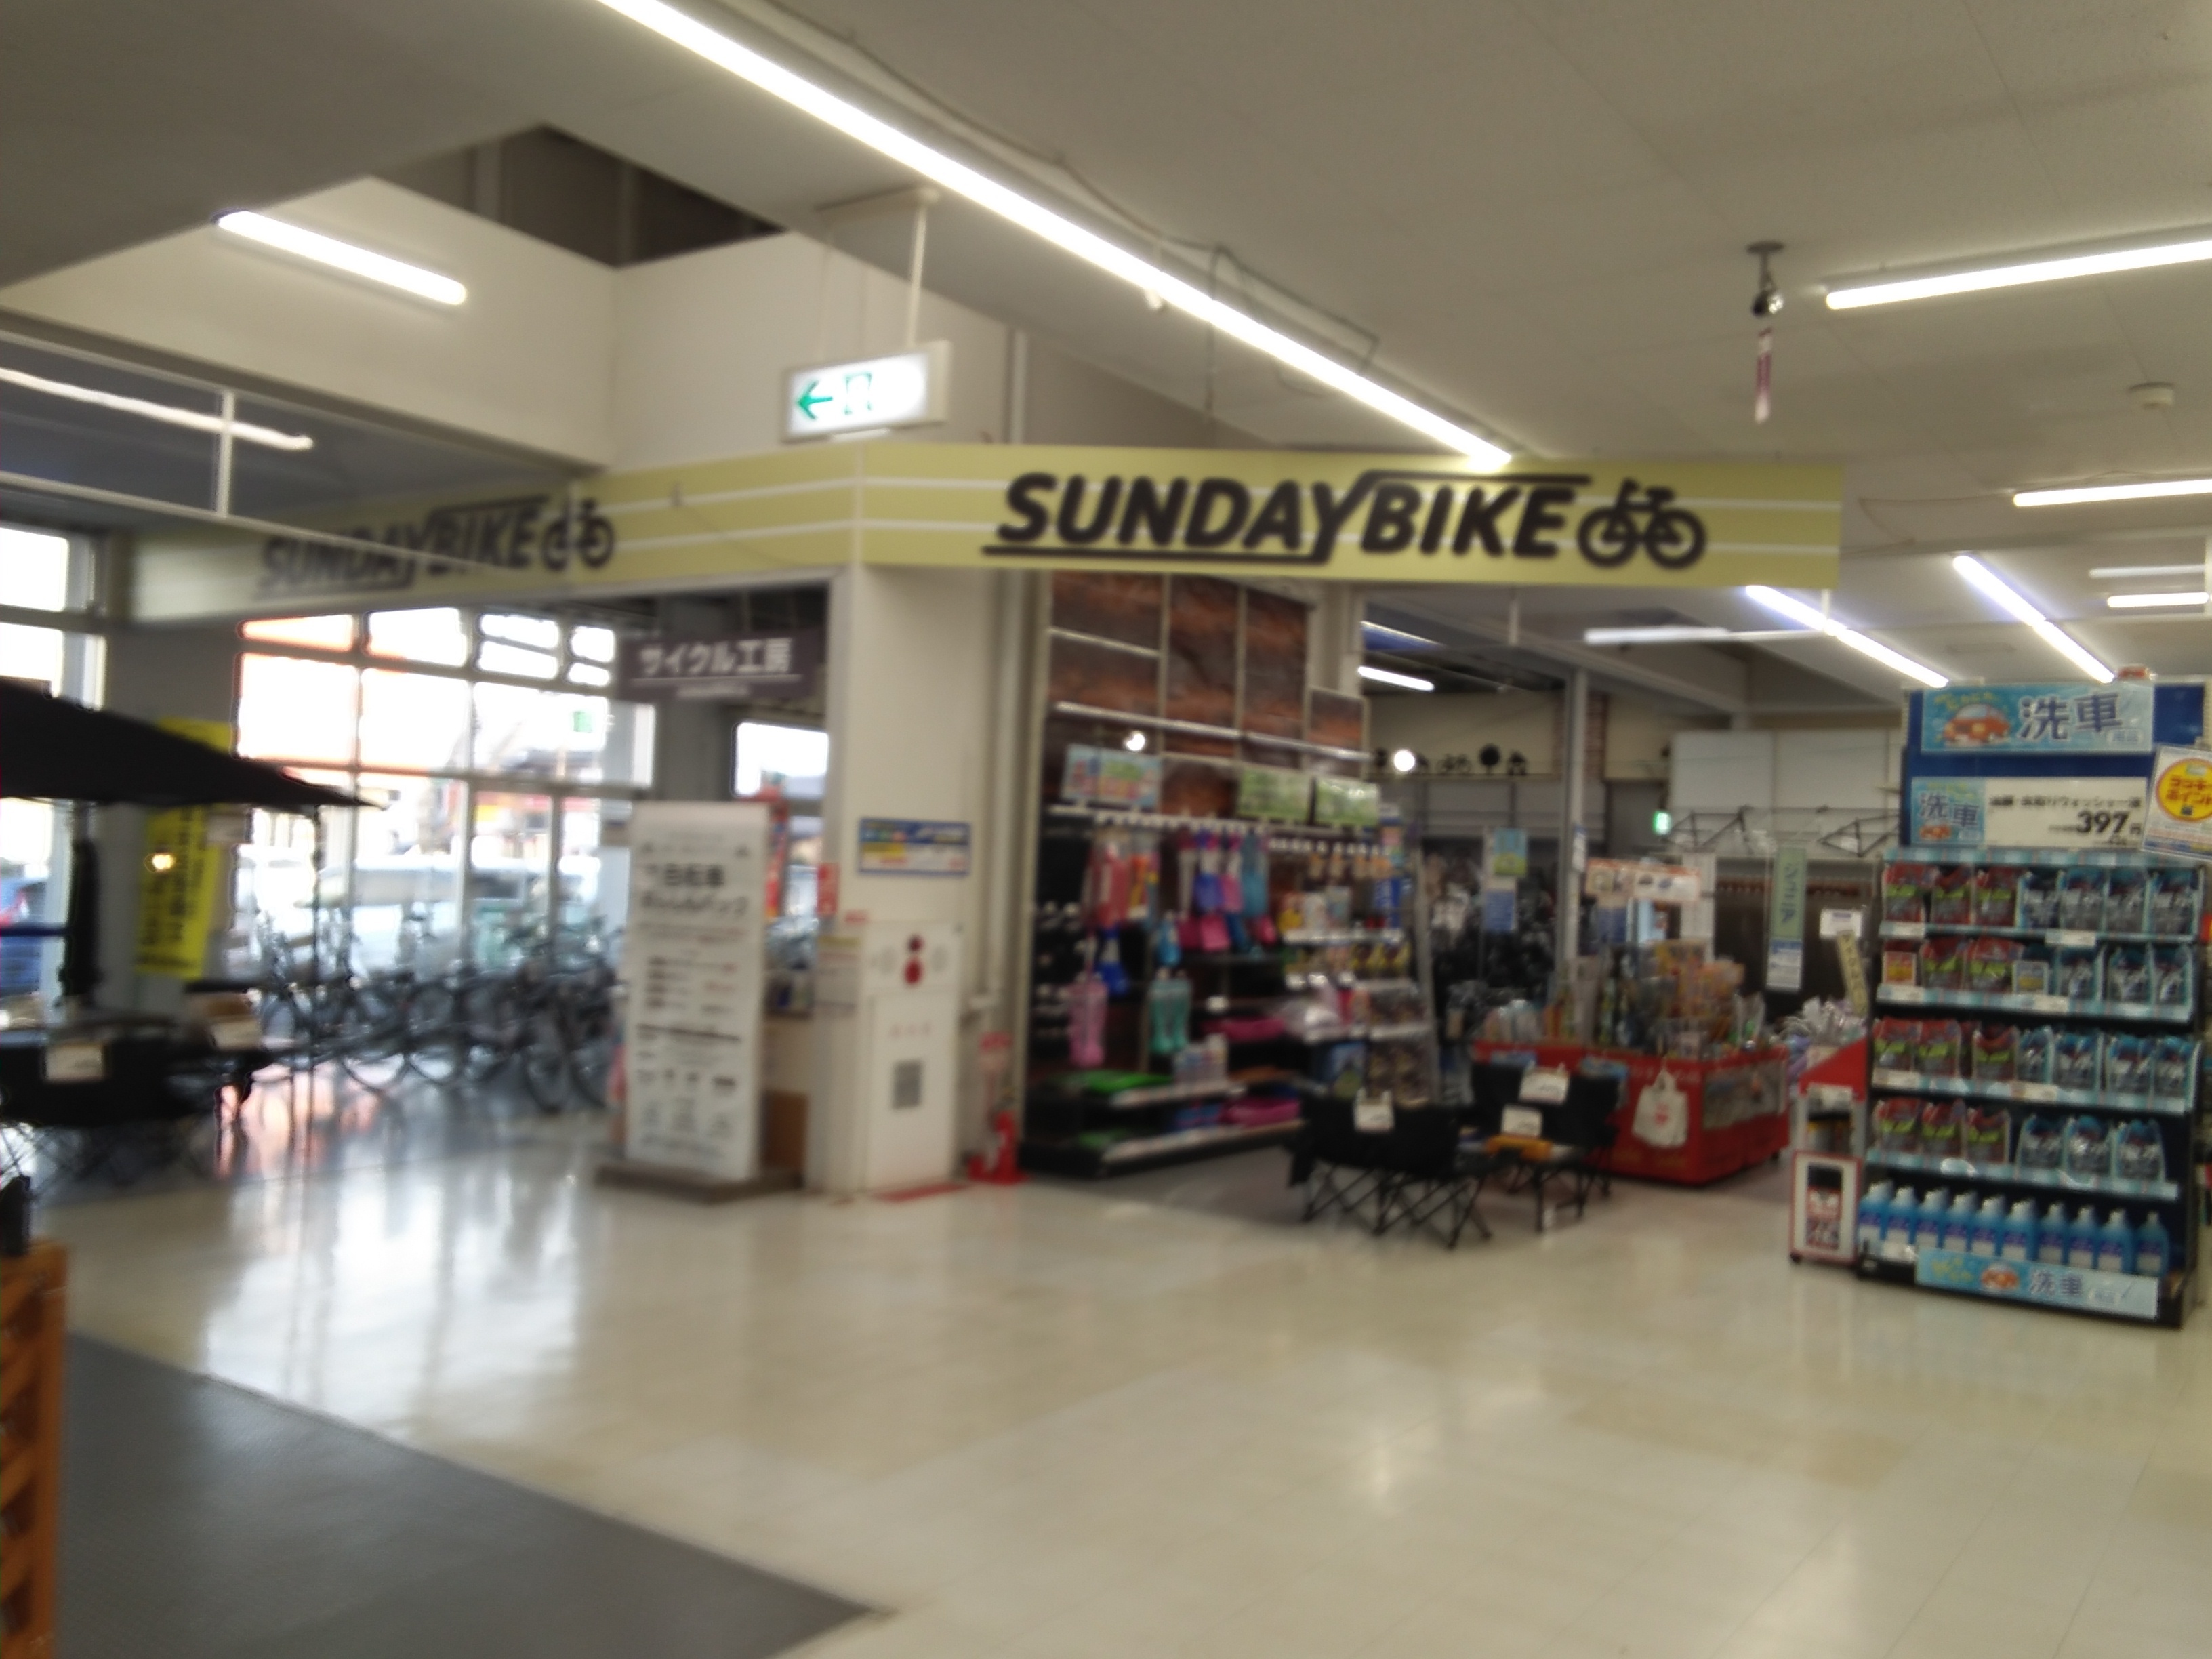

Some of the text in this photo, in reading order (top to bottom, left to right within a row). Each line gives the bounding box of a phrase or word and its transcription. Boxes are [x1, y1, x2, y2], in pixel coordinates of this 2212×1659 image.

[640, 637, 792, 674] サイクル工房
[2018, 692, 2123, 740] 洗車
[1919, 792, 1978, 827] 洗車
